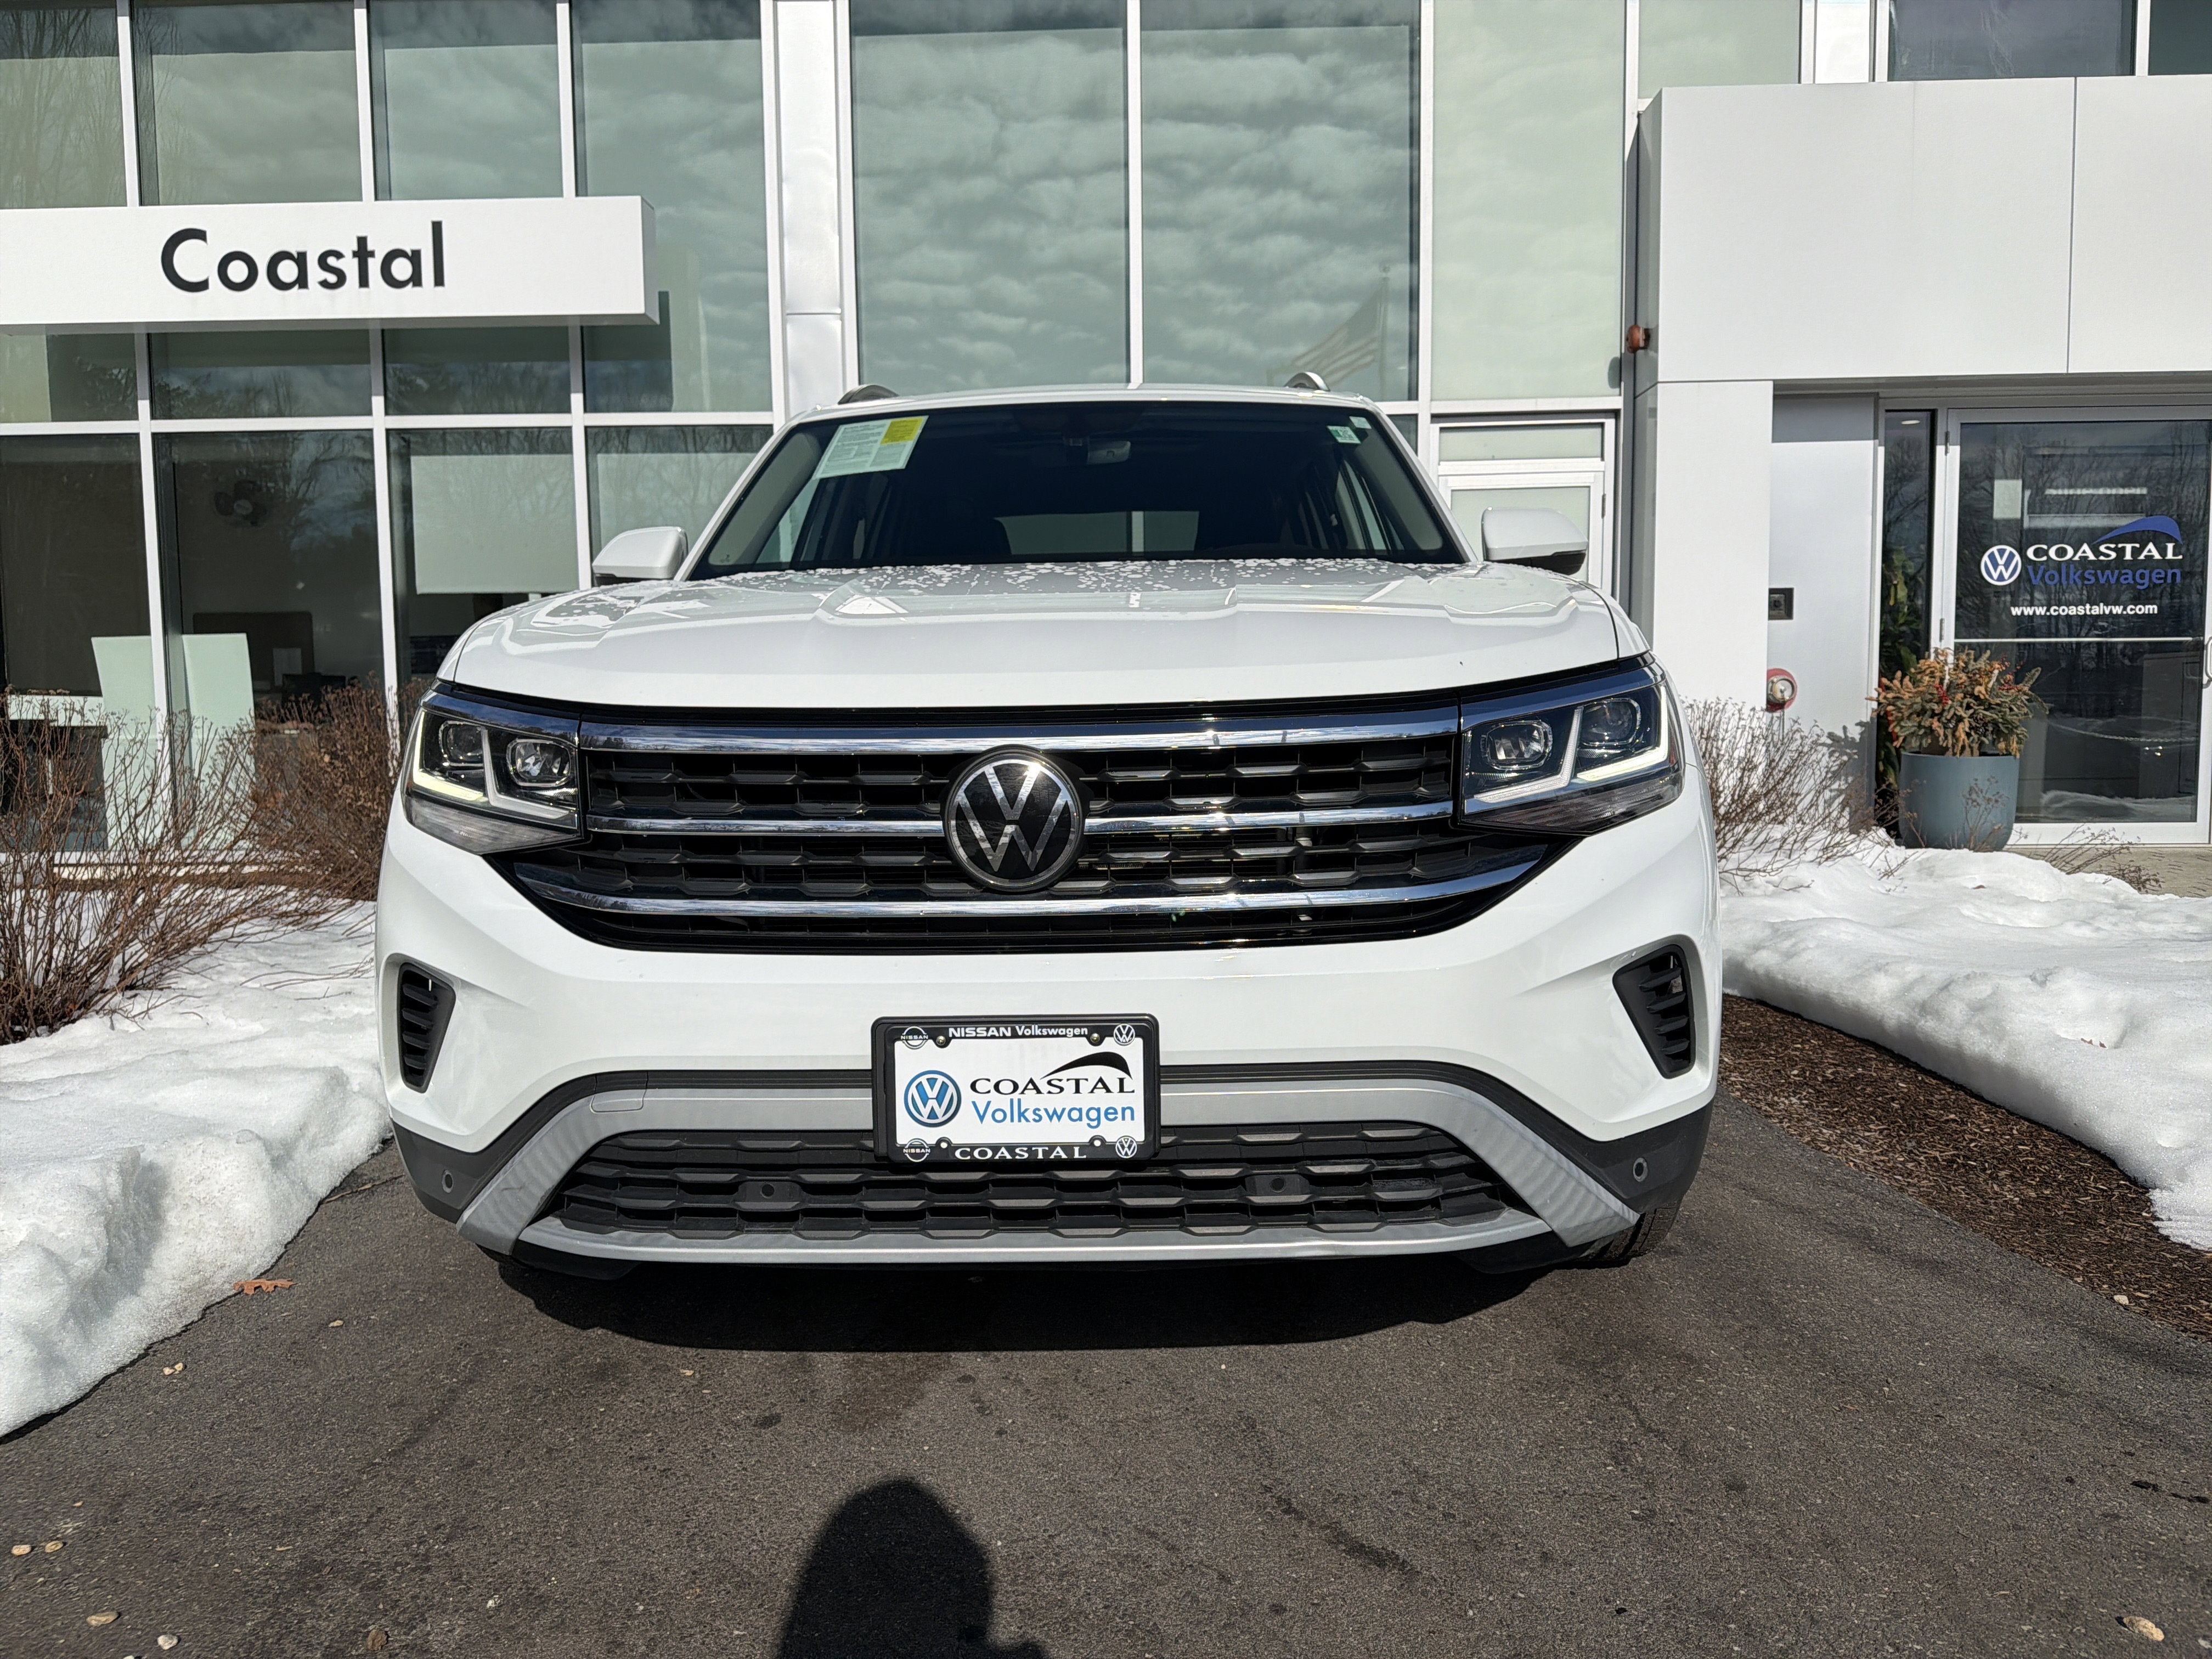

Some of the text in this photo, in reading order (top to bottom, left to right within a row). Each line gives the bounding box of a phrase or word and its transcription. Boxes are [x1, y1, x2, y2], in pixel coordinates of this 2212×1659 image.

[161, 220, 445, 292] Coastal
[2026, 542, 2183, 561] COASTAL
[2027, 564, 2181, 590] Volkswagen
[2011, 602, 2158, 616] www.coastalvw.com
[949, 1025, 1088, 1038] NISSAN Volkswagen
[969, 1077, 1135, 1095] COASTAL
[971, 1098, 1136, 1129] Volkswagen
[955, 1146, 1086, 1160] COASTAL
